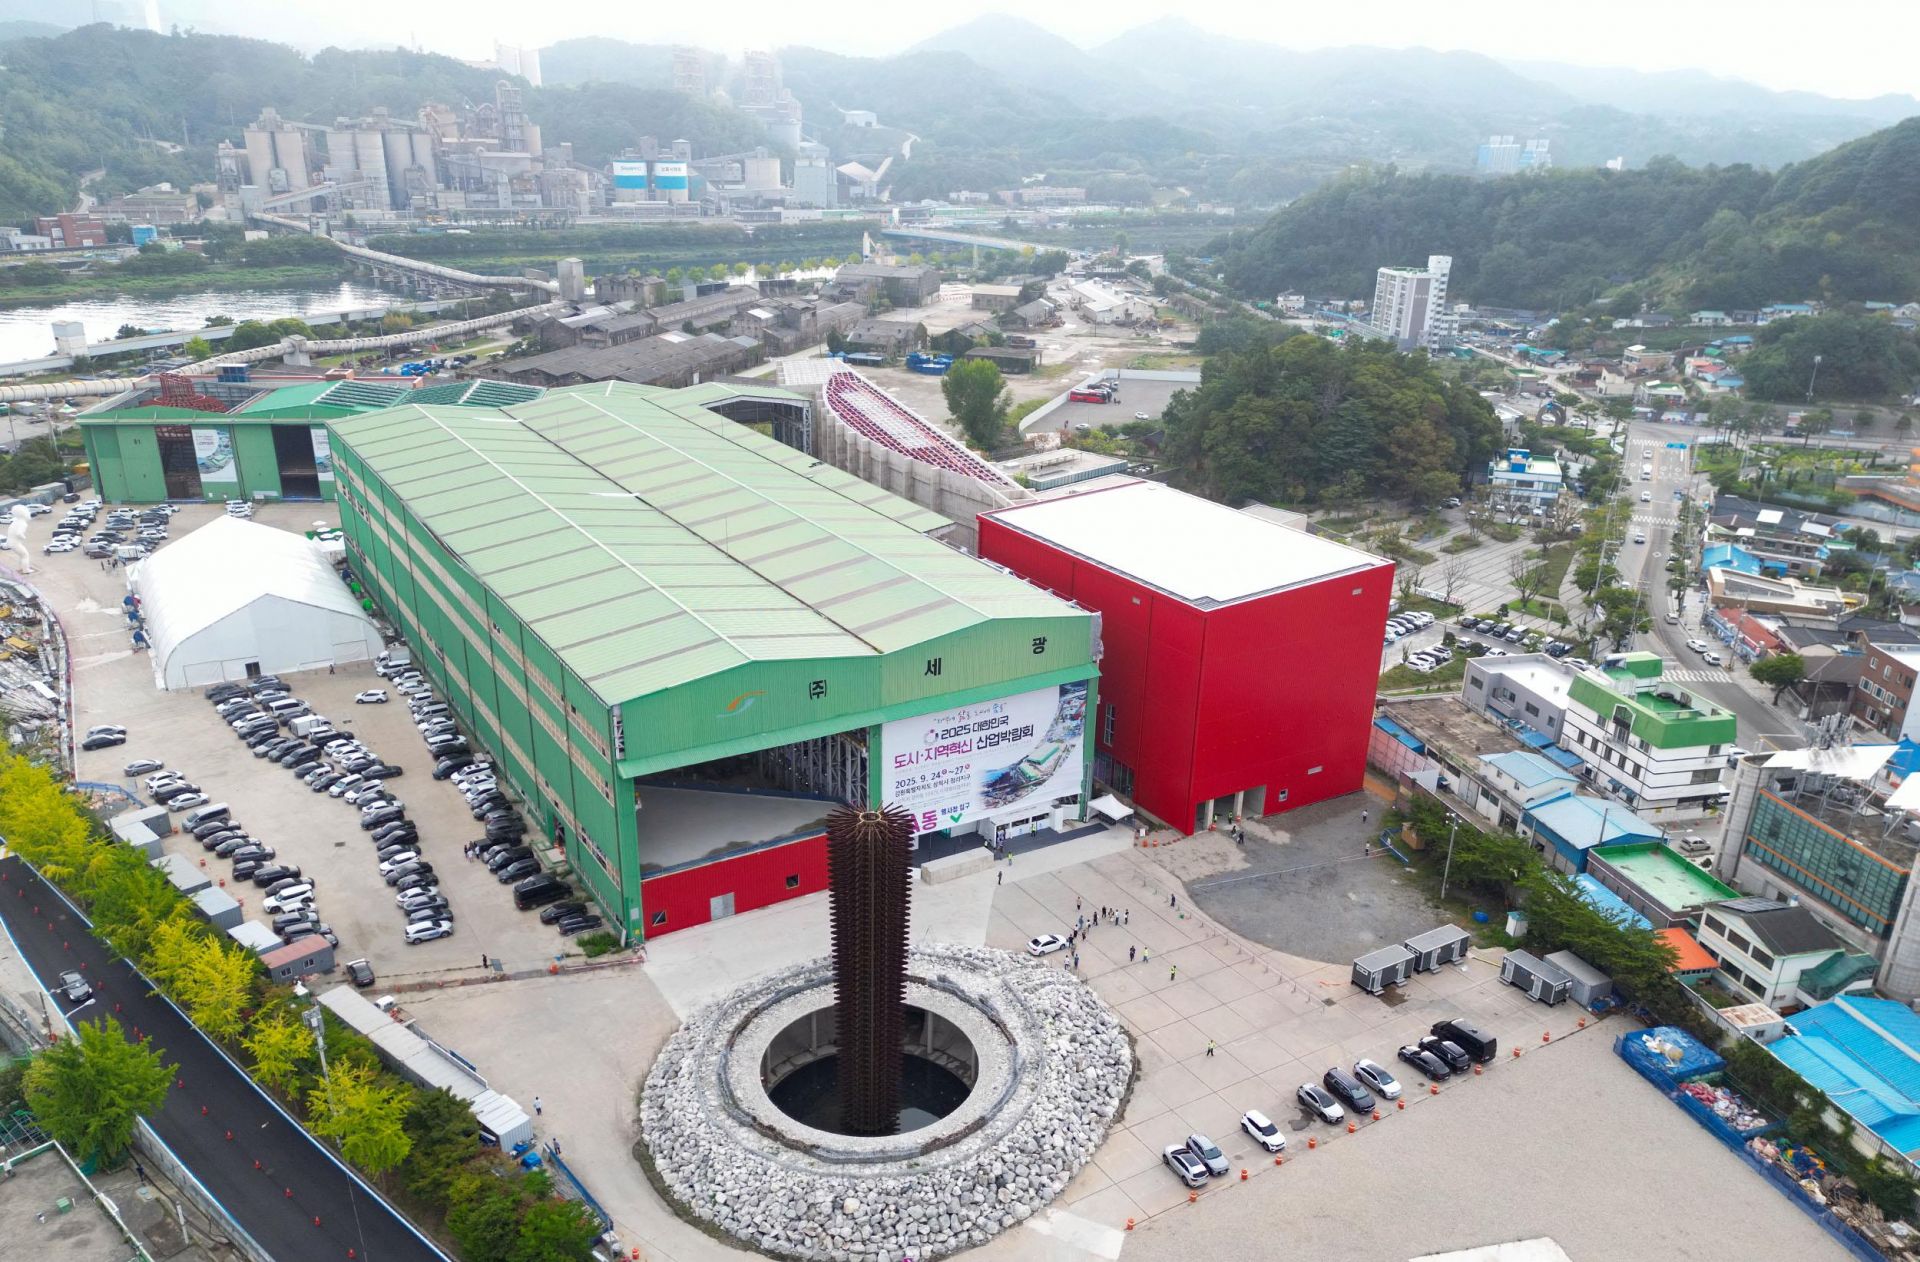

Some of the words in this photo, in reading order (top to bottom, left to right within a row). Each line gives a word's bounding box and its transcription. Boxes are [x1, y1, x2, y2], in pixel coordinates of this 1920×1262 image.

[924, 657, 942, 677] 세
[1032, 636, 1047, 655] 광
[941, 724, 971, 740] 2025
[972, 715, 1009, 732] 대한민국
[976, 724, 1034, 750] 산업박람회
